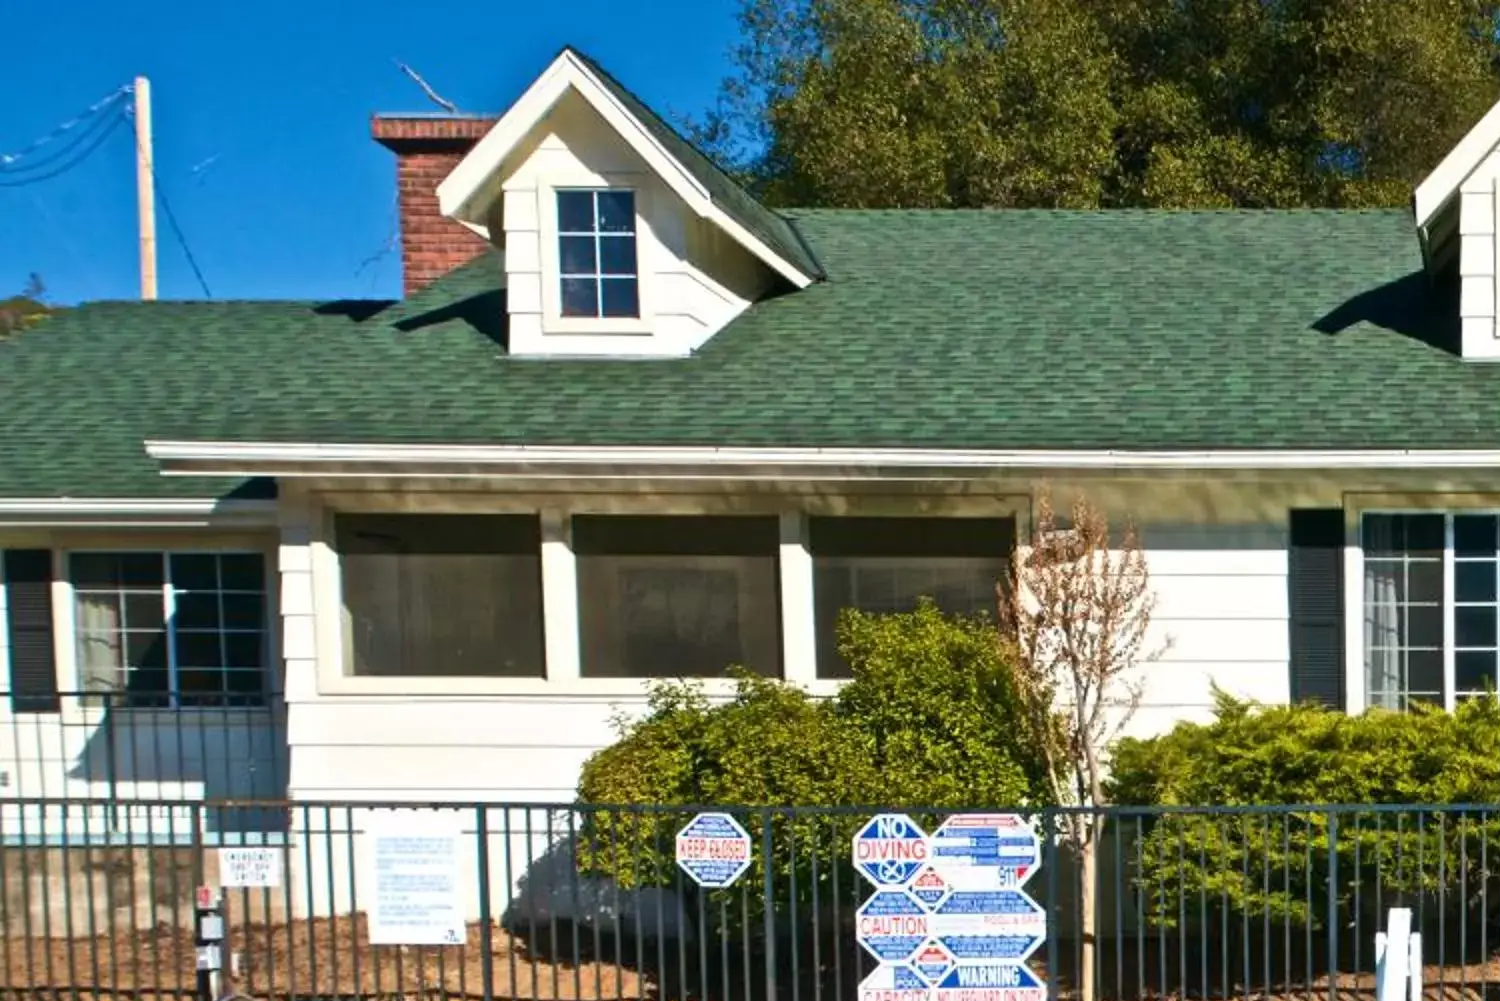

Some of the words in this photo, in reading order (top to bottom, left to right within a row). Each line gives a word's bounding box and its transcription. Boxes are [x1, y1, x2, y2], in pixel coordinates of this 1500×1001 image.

[877, 817, 907, 839] NO
[857, 839, 927, 860] DIVING
[999, 866, 1017, 887] 911
[861, 916, 928, 935] CAUTION
[957, 965, 1021, 988] WARNING
